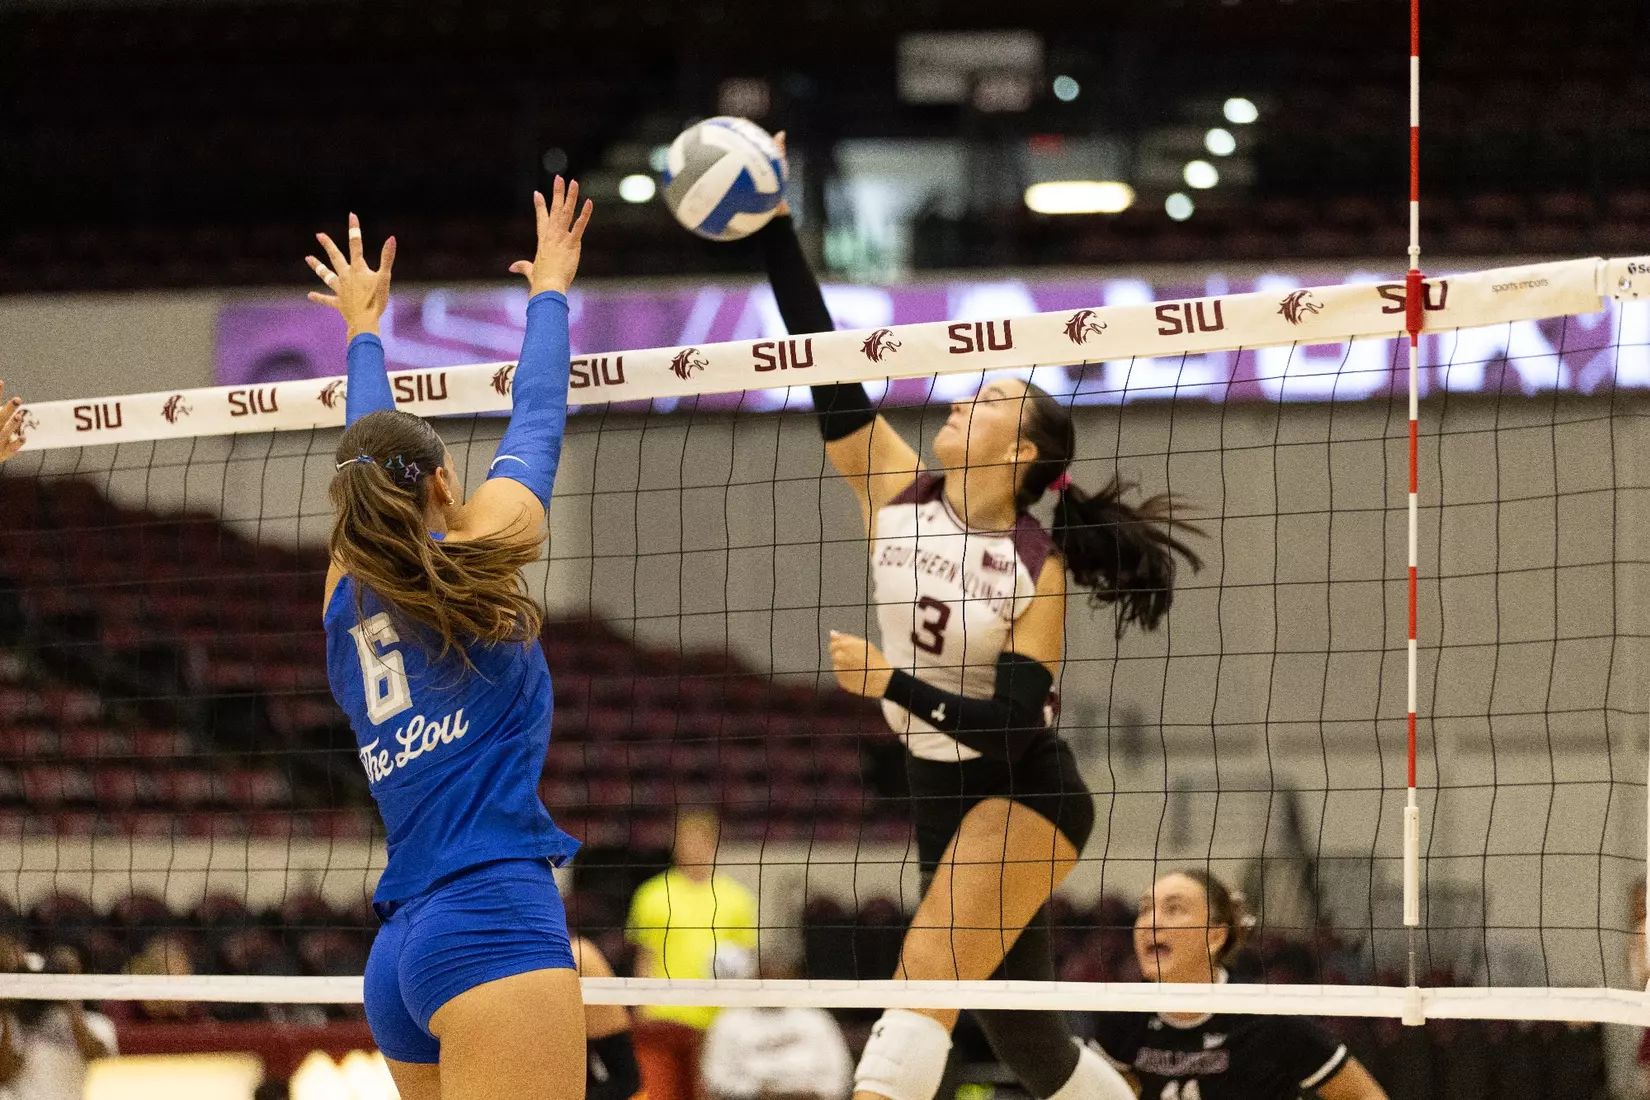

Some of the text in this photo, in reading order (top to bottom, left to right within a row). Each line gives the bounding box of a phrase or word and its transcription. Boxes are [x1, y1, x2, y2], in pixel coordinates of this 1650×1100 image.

[1376, 280, 1449, 314] SU
[1154, 300, 1225, 336] SIU
[947, 319, 1013, 354] SIU
[569, 356, 625, 388] SIU
[752, 338, 814, 373] SIU
[227, 388, 279, 417] SIU
[393, 372, 448, 404] SIU
[73, 402, 123, 432] SIU
[911, 595, 951, 656] 3
[347, 612, 413, 726] 6
[360, 707, 470, 785] The Lou
